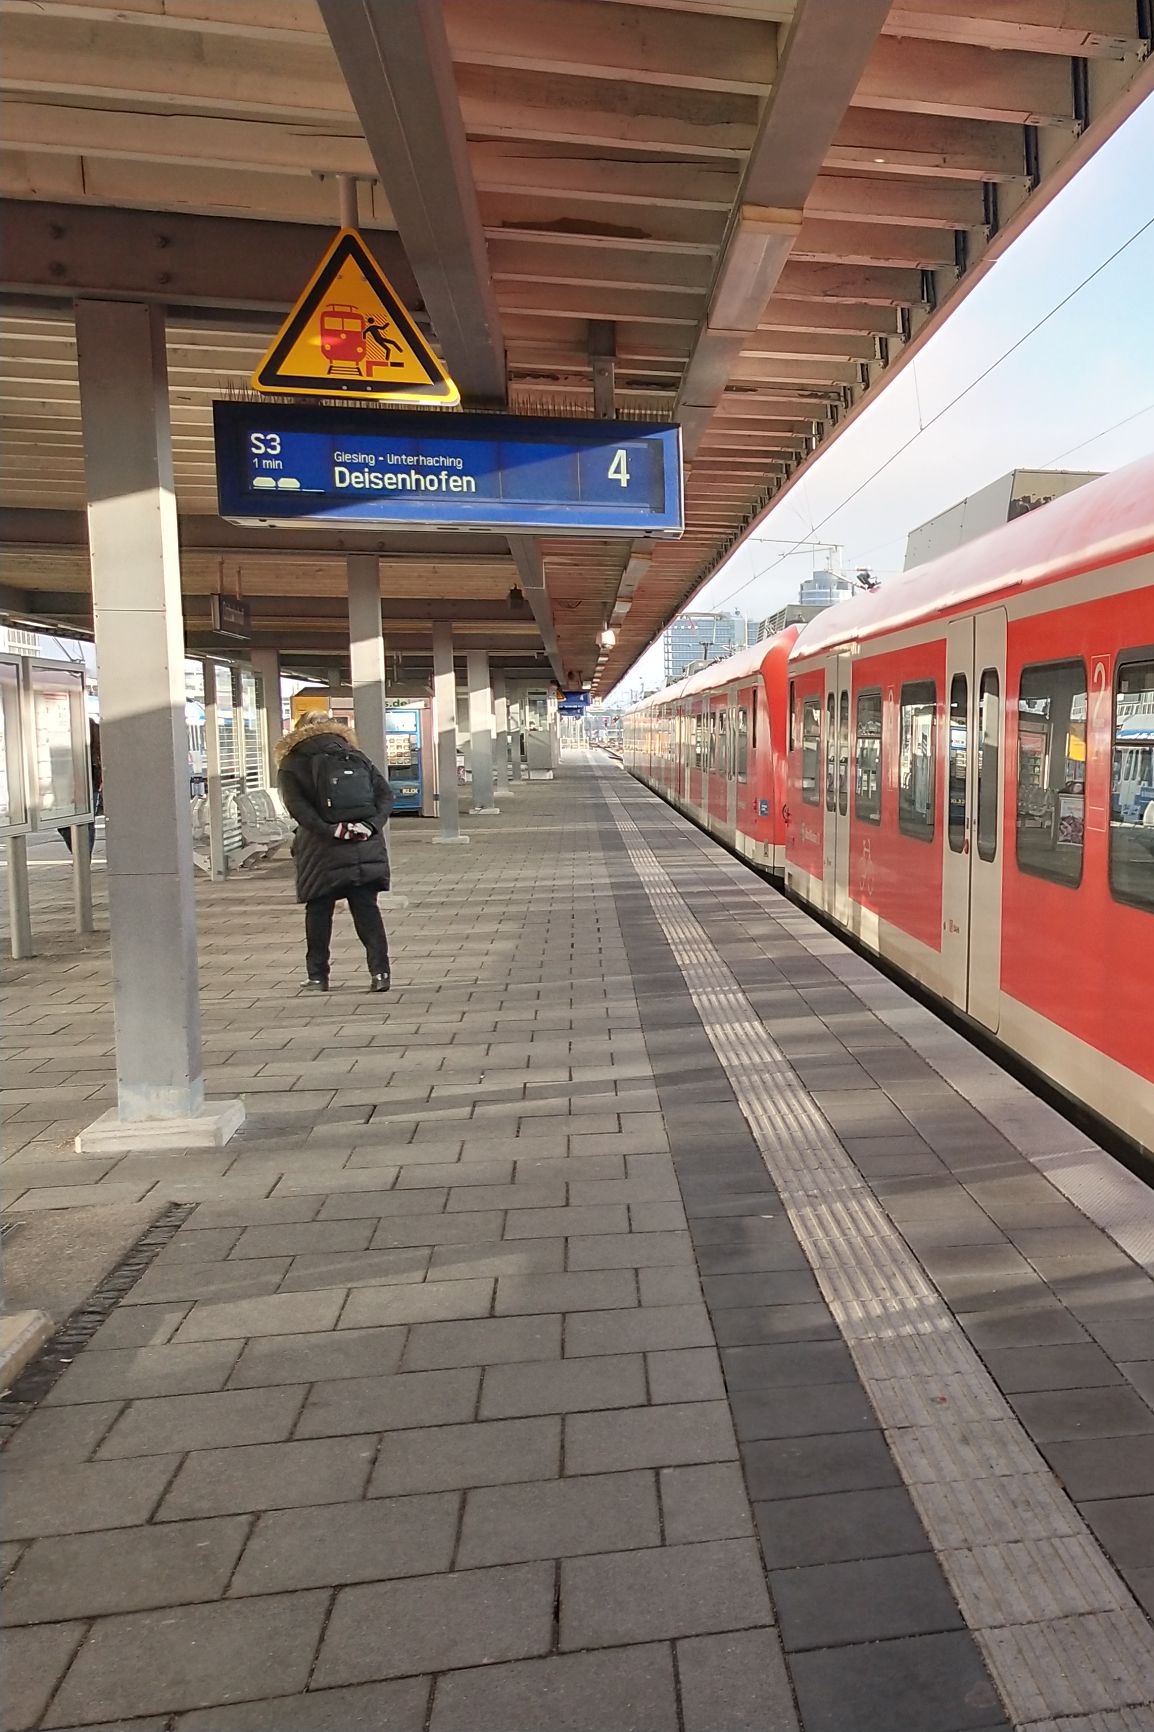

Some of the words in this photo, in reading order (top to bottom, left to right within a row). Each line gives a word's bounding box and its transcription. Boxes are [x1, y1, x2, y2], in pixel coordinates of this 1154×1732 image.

[250, 432, 281, 455] S3
[252, 458, 259, 469] 1
[262, 458, 283, 470] min
[334, 451, 376, 467] Giesing
[386, 453, 463, 470] Unterhaching
[607, 449, 630, 488] 4
[333, 466, 476, 493] Deisenhofen
